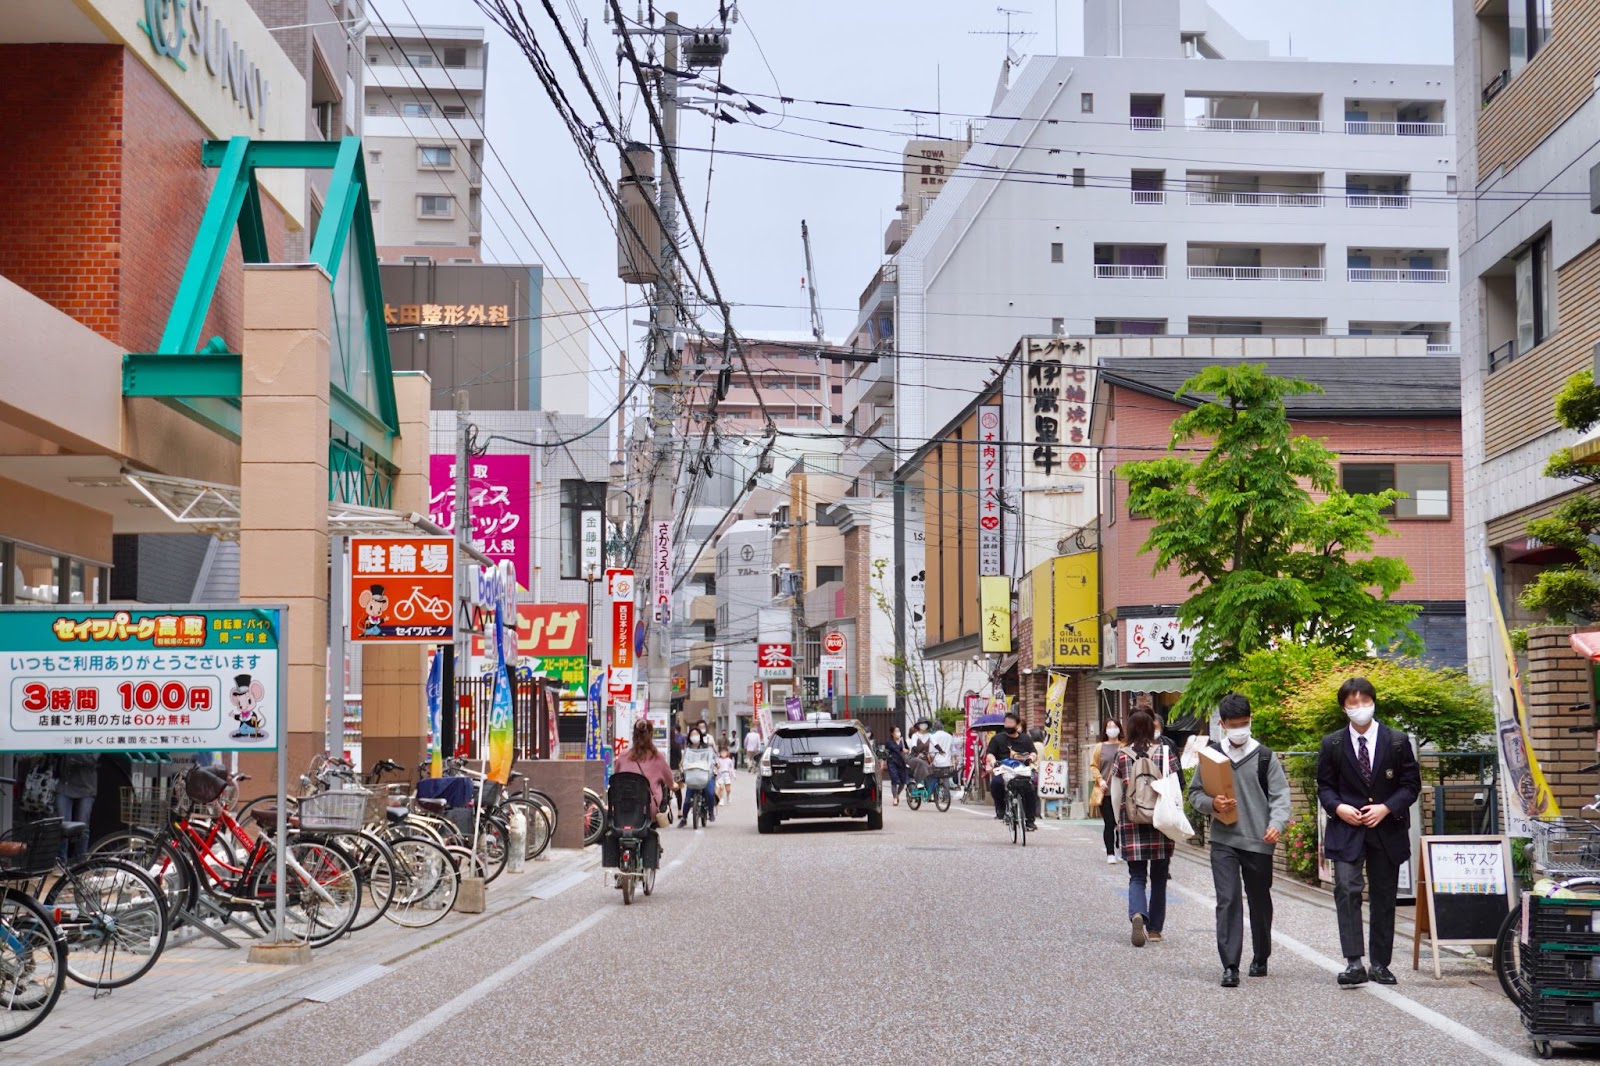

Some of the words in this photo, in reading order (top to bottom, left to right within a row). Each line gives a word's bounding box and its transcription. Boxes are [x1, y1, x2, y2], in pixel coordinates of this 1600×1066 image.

[188, 0, 270, 132] SUNNY
[921, 150, 945, 158] TOWA
[1029, 341, 1086, 356] ニクヤキ
[1065, 368, 1087, 443] 七輪焼き
[586, 516, 597, 567] 金藤歯
[357, 545, 448, 573] 駐輪場
[395, 626, 447, 636] セイワパーク
[618, 605, 629, 664] 西日本シティ銀行
[987, 613, 1001, 642] 友志
[219, 632, 268, 644] 同一料金
[761, 644, 790, 667] 茶
[1059, 644, 1091, 656] BAR
[10, 654, 261, 671] いつもご利用ありがとうございます
[543, 658, 585, 671] スピードサービス
[561, 671, 585, 684] 無料
[23, 683, 99, 711] 3時間
[119, 682, 212, 710] 100円
[38, 714, 191, 726] 店舗ご利用の方は60分無料
[1040, 785, 1065, 795] もり山
[1453, 852, 1498, 866] 布マスク
